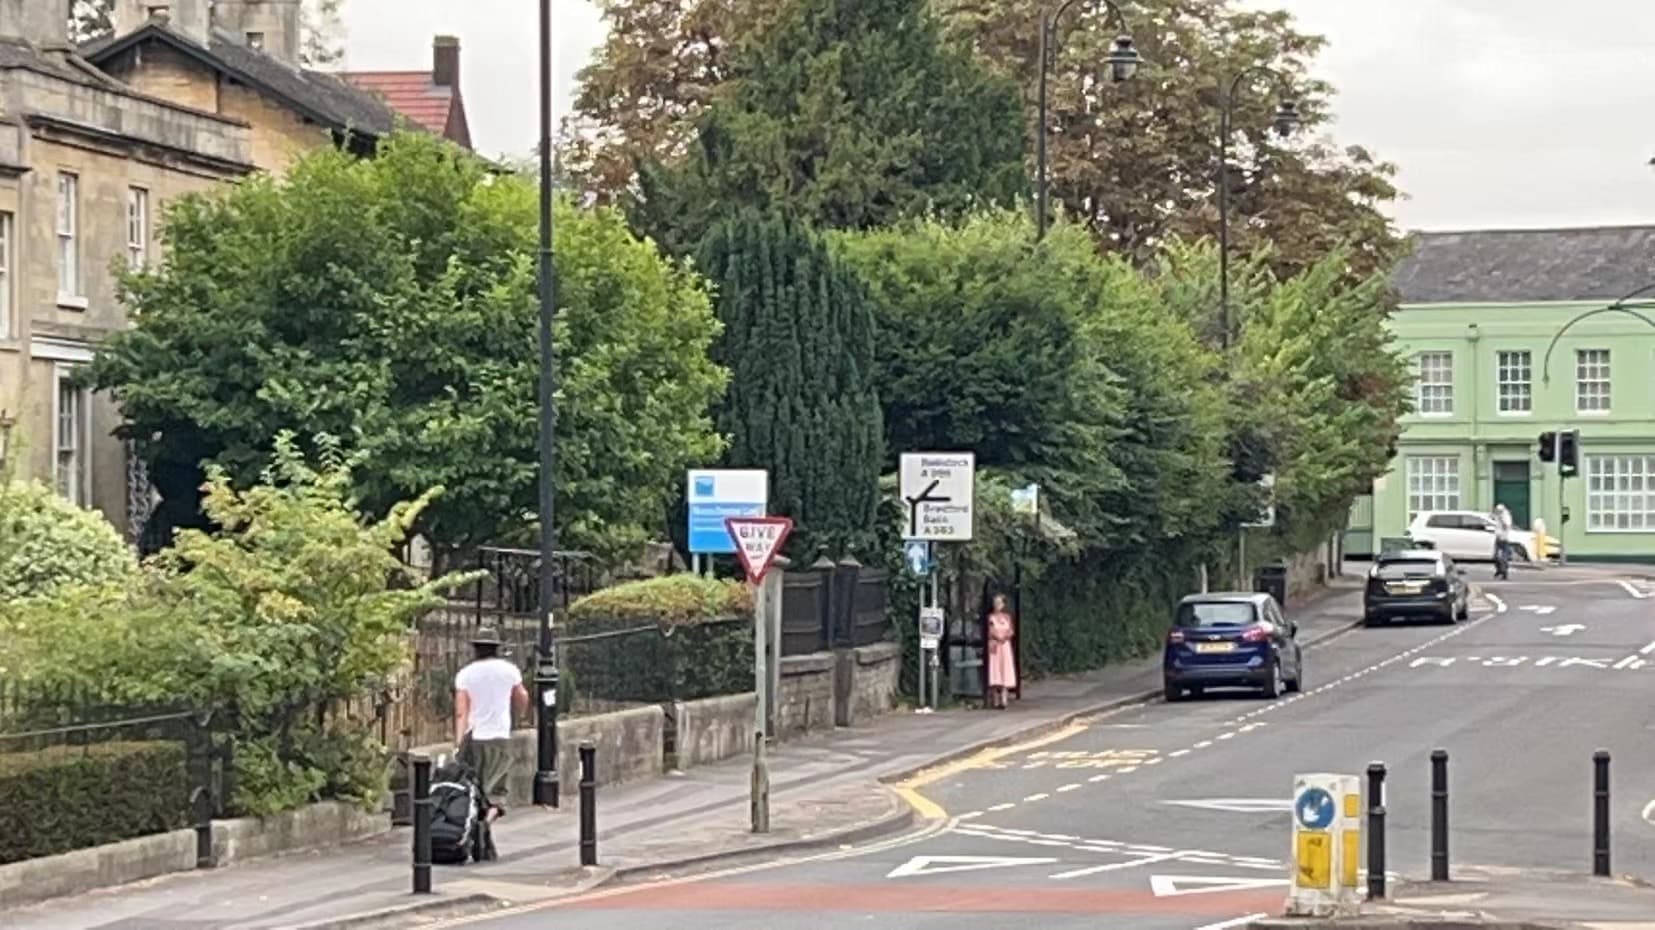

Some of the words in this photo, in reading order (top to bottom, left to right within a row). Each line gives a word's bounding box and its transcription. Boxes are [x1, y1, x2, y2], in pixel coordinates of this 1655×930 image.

[740, 526, 776, 539] GIVE
[924, 526, 931, 534] A
[745, 543, 771, 552] WAY
